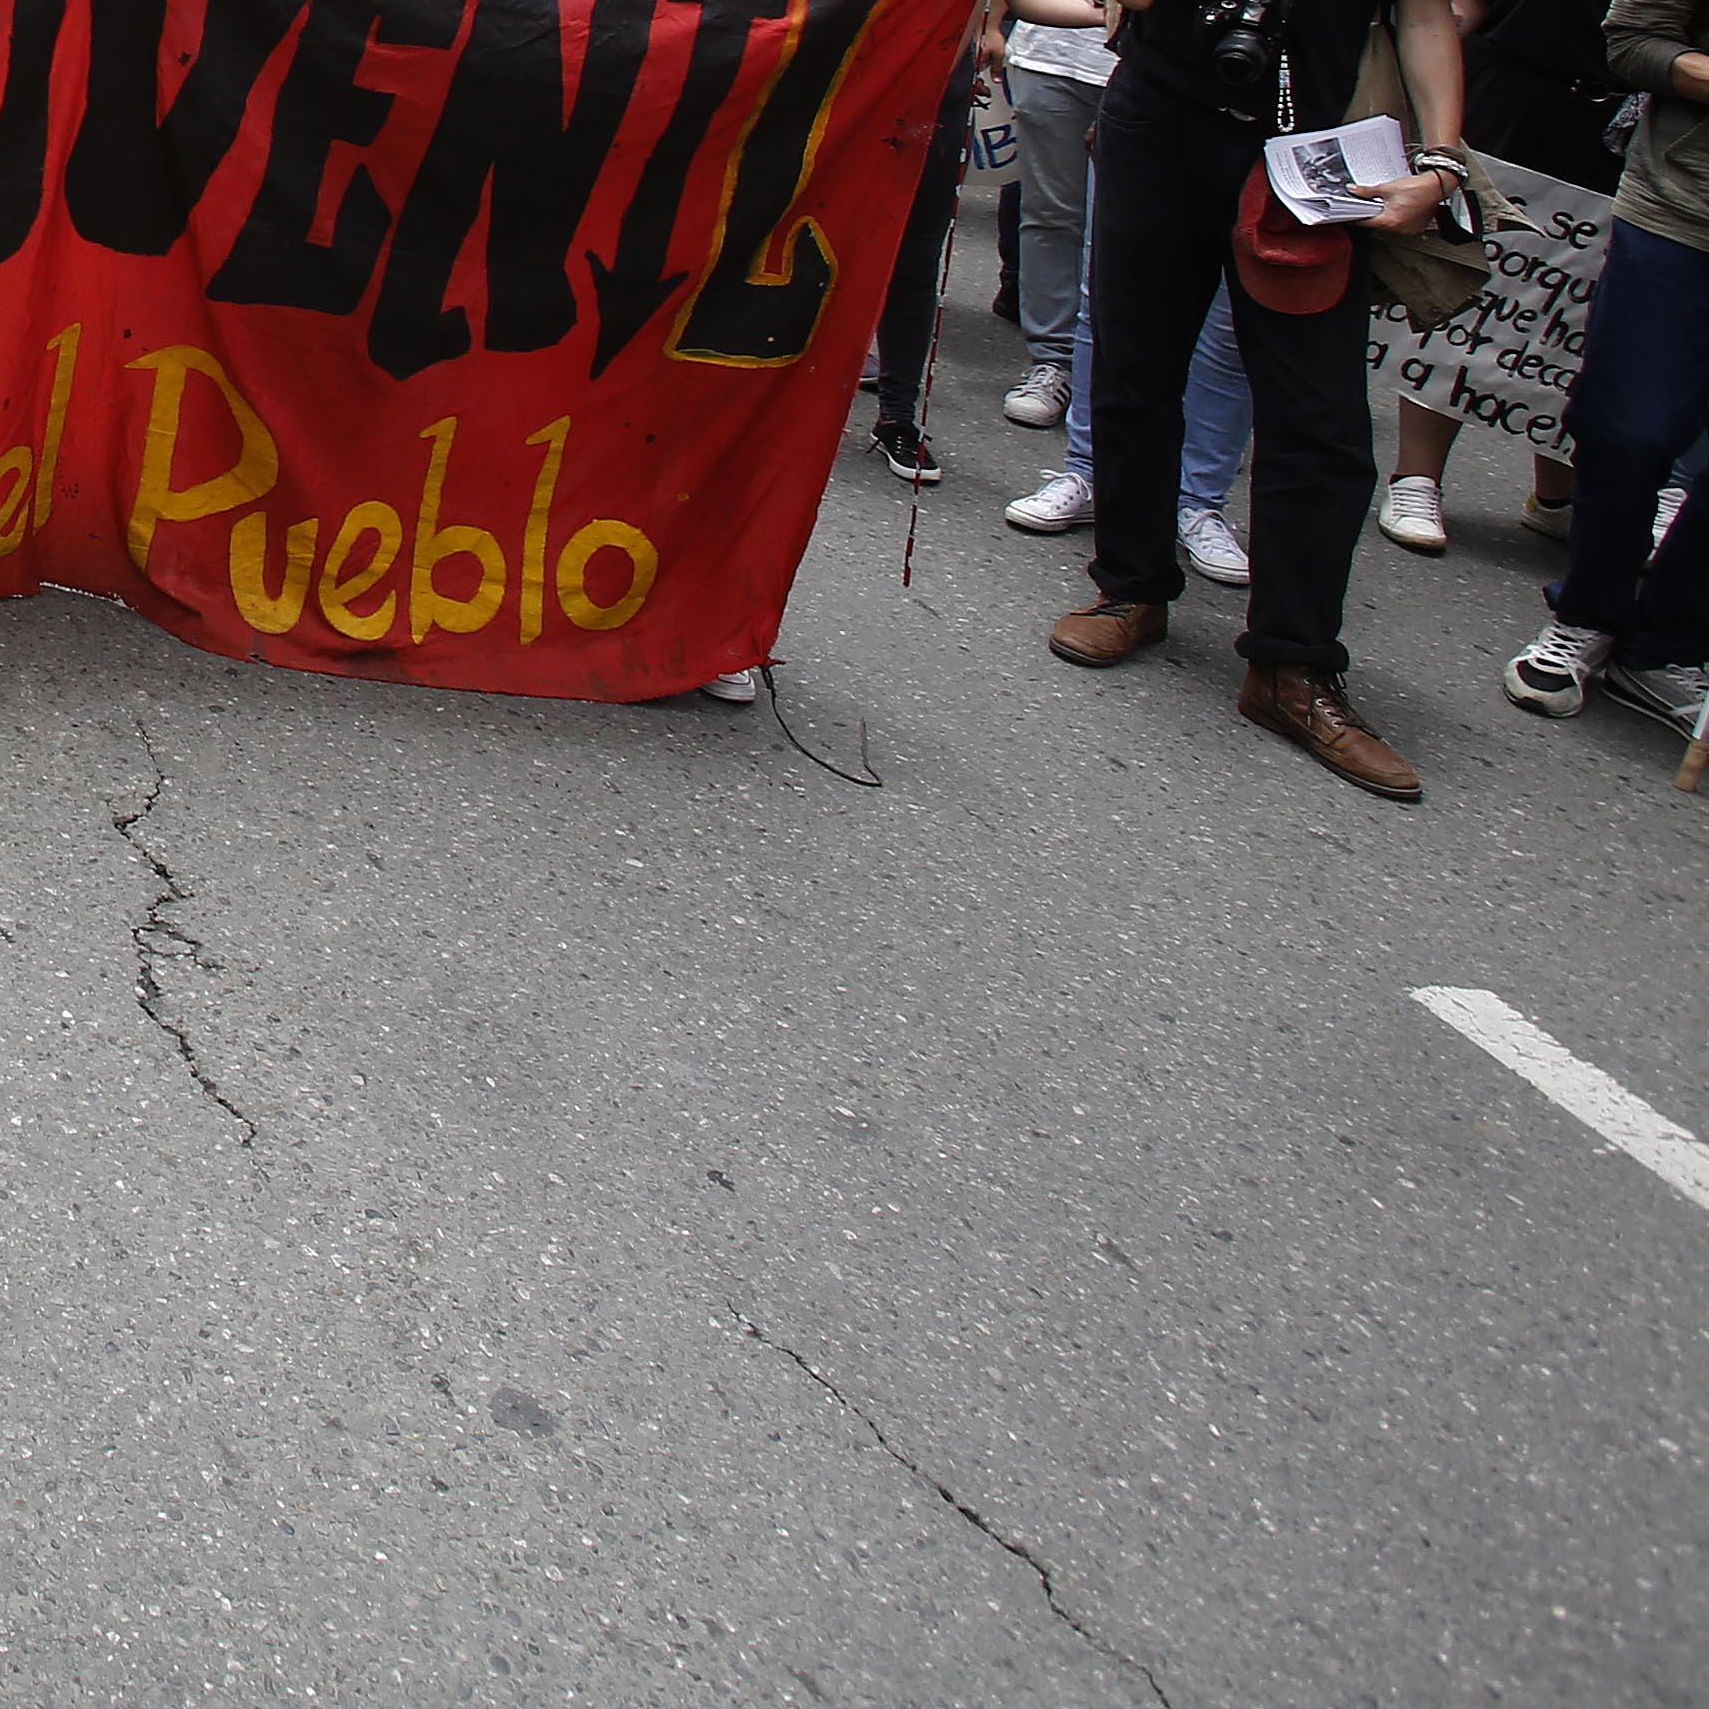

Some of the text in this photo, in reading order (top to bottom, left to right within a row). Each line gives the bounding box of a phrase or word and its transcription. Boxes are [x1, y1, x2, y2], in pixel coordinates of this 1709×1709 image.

[1543, 210, 1599, 250] se
[1483, 238, 1598, 316] porqu
[1495, 340, 1577, 394] deca
[124, 343, 660, 646] Pueblo
